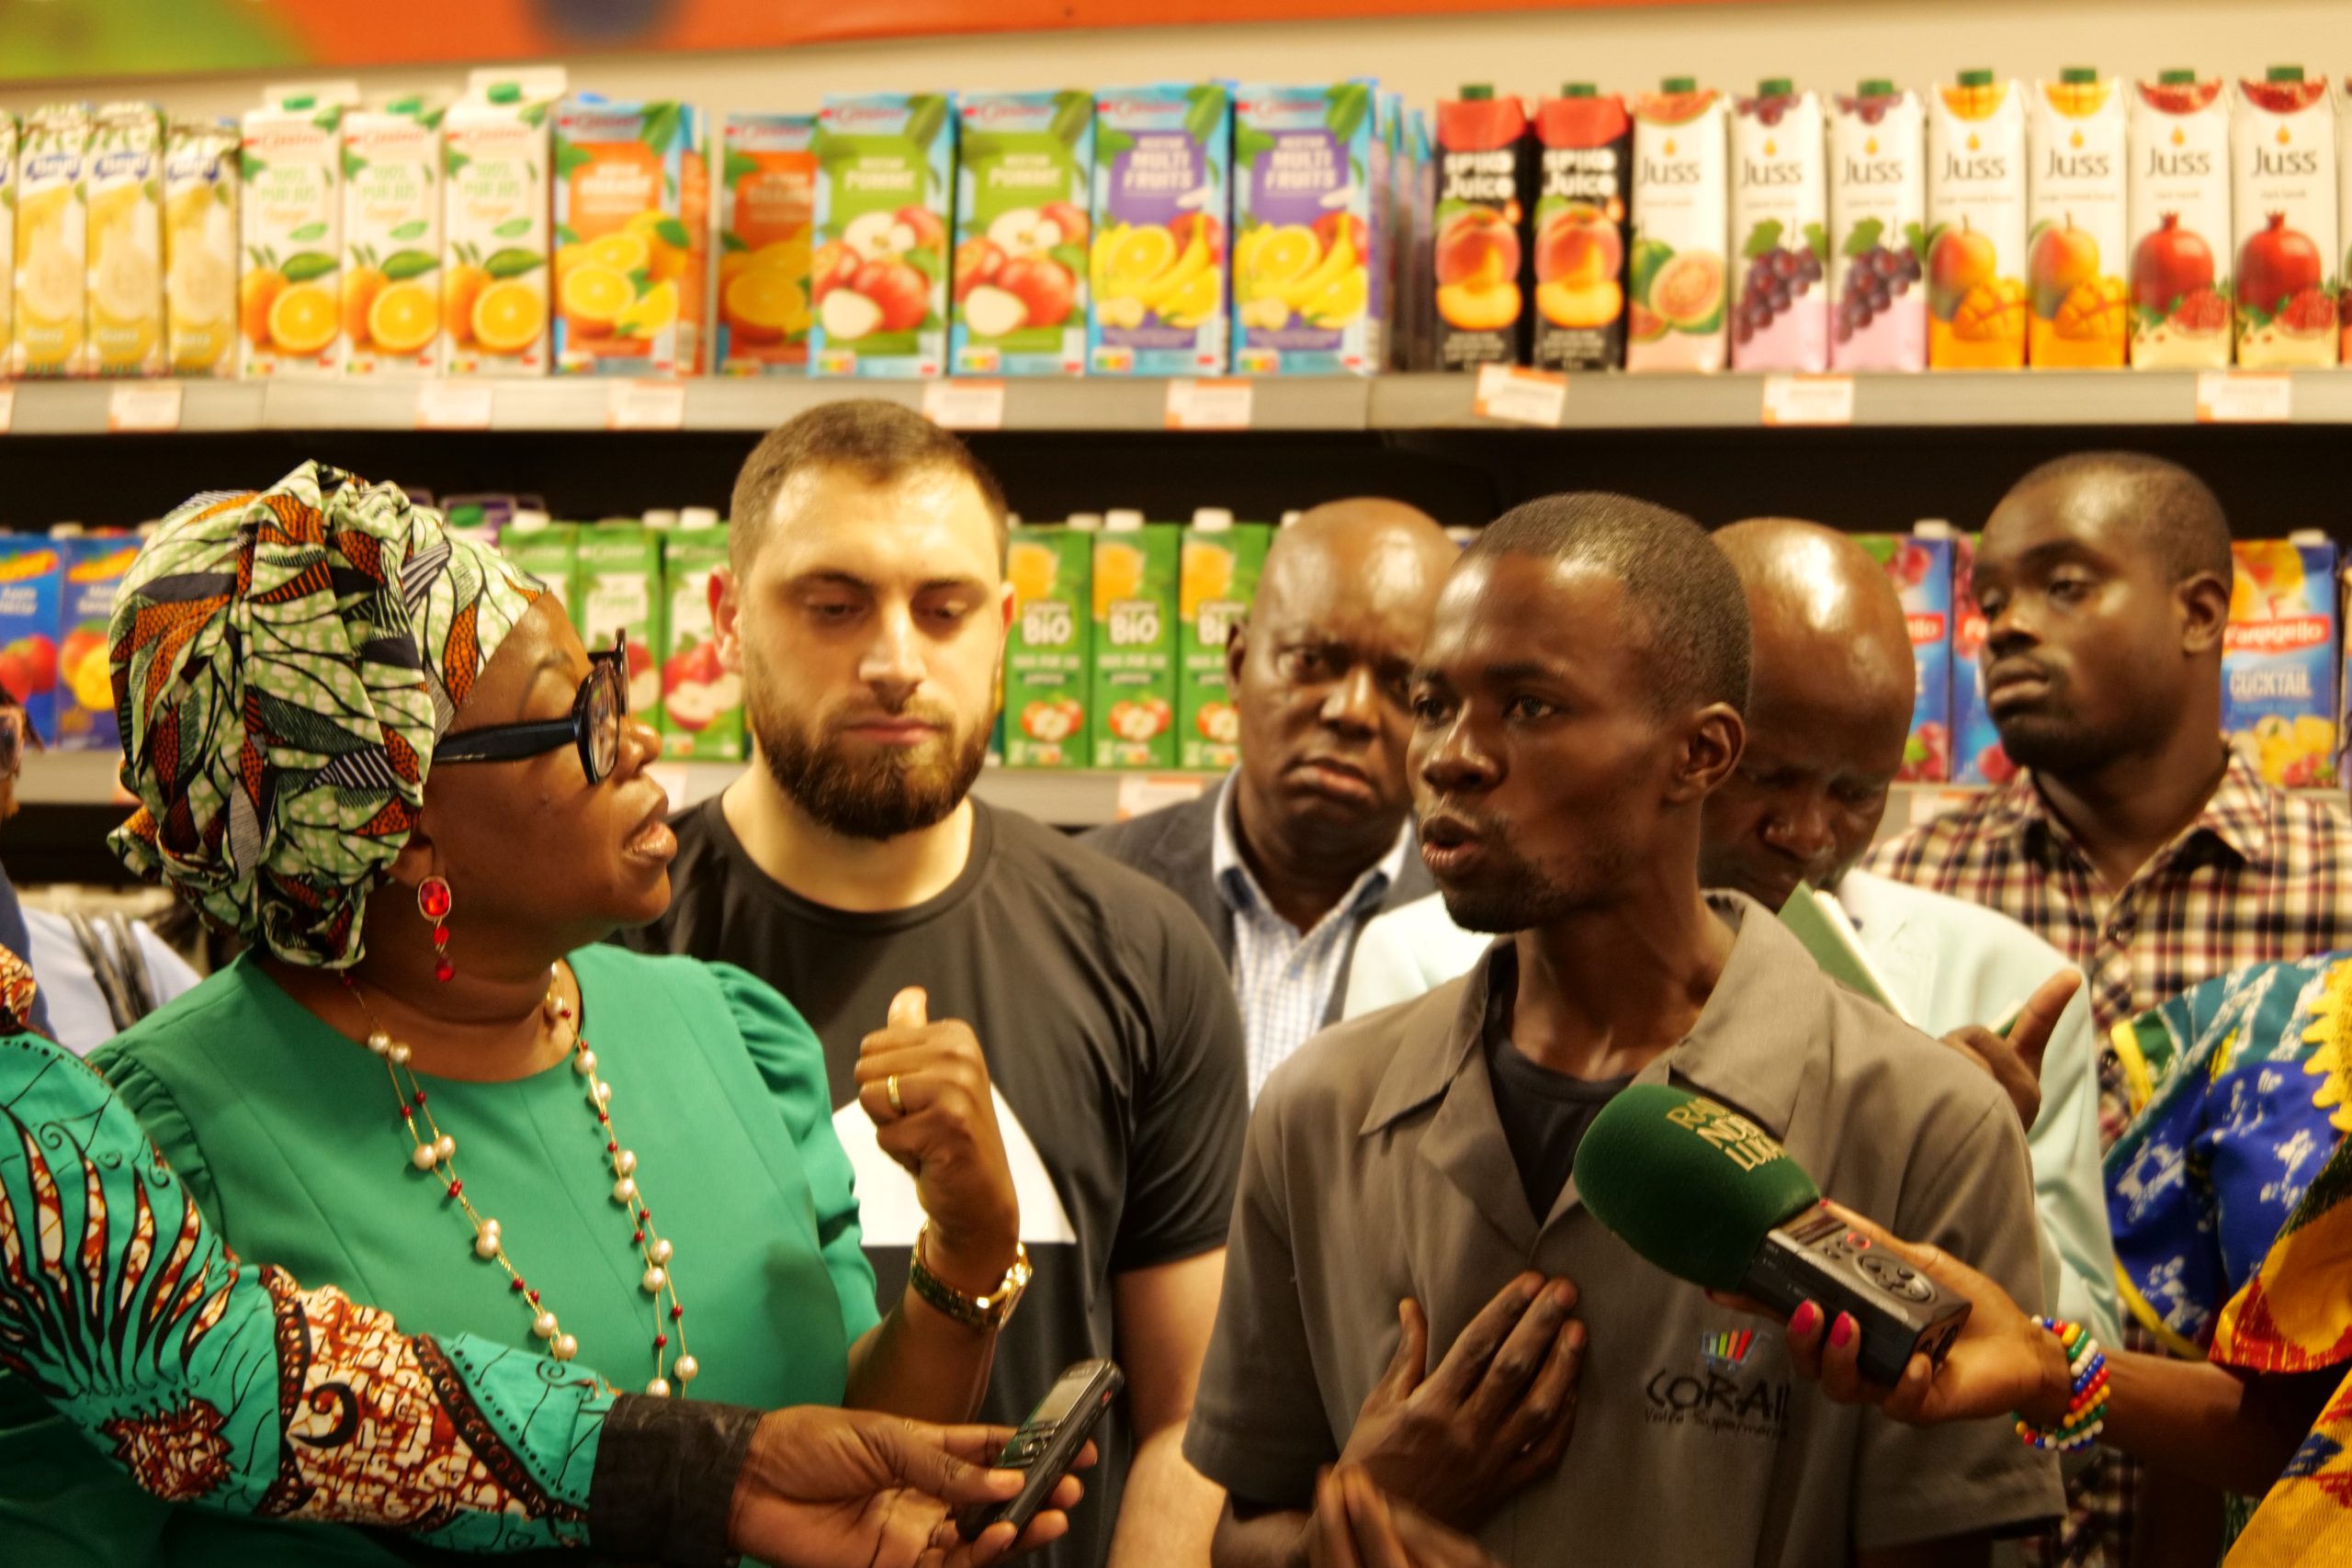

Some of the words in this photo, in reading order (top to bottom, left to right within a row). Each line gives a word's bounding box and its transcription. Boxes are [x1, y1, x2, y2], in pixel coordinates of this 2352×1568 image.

[1131, 151, 1191, 167] MULTI
[1272, 151, 1332, 167] MULTI
[1638, 159, 1700, 185] Juss
[1745, 158, 1803, 186] Juss
[1844, 155, 1903, 186] Juss
[1942, 152, 2005, 182] Juss
[2045, 148, 2109, 180] Juss
[2145, 148, 2211, 179] Juss
[2253, 147, 2317, 178] Juss
[1124, 169, 1193, 189] FRUITS
[1266, 169, 1337, 189] FRUITS
[2230, 670, 2312, 701] COCKTAIL
